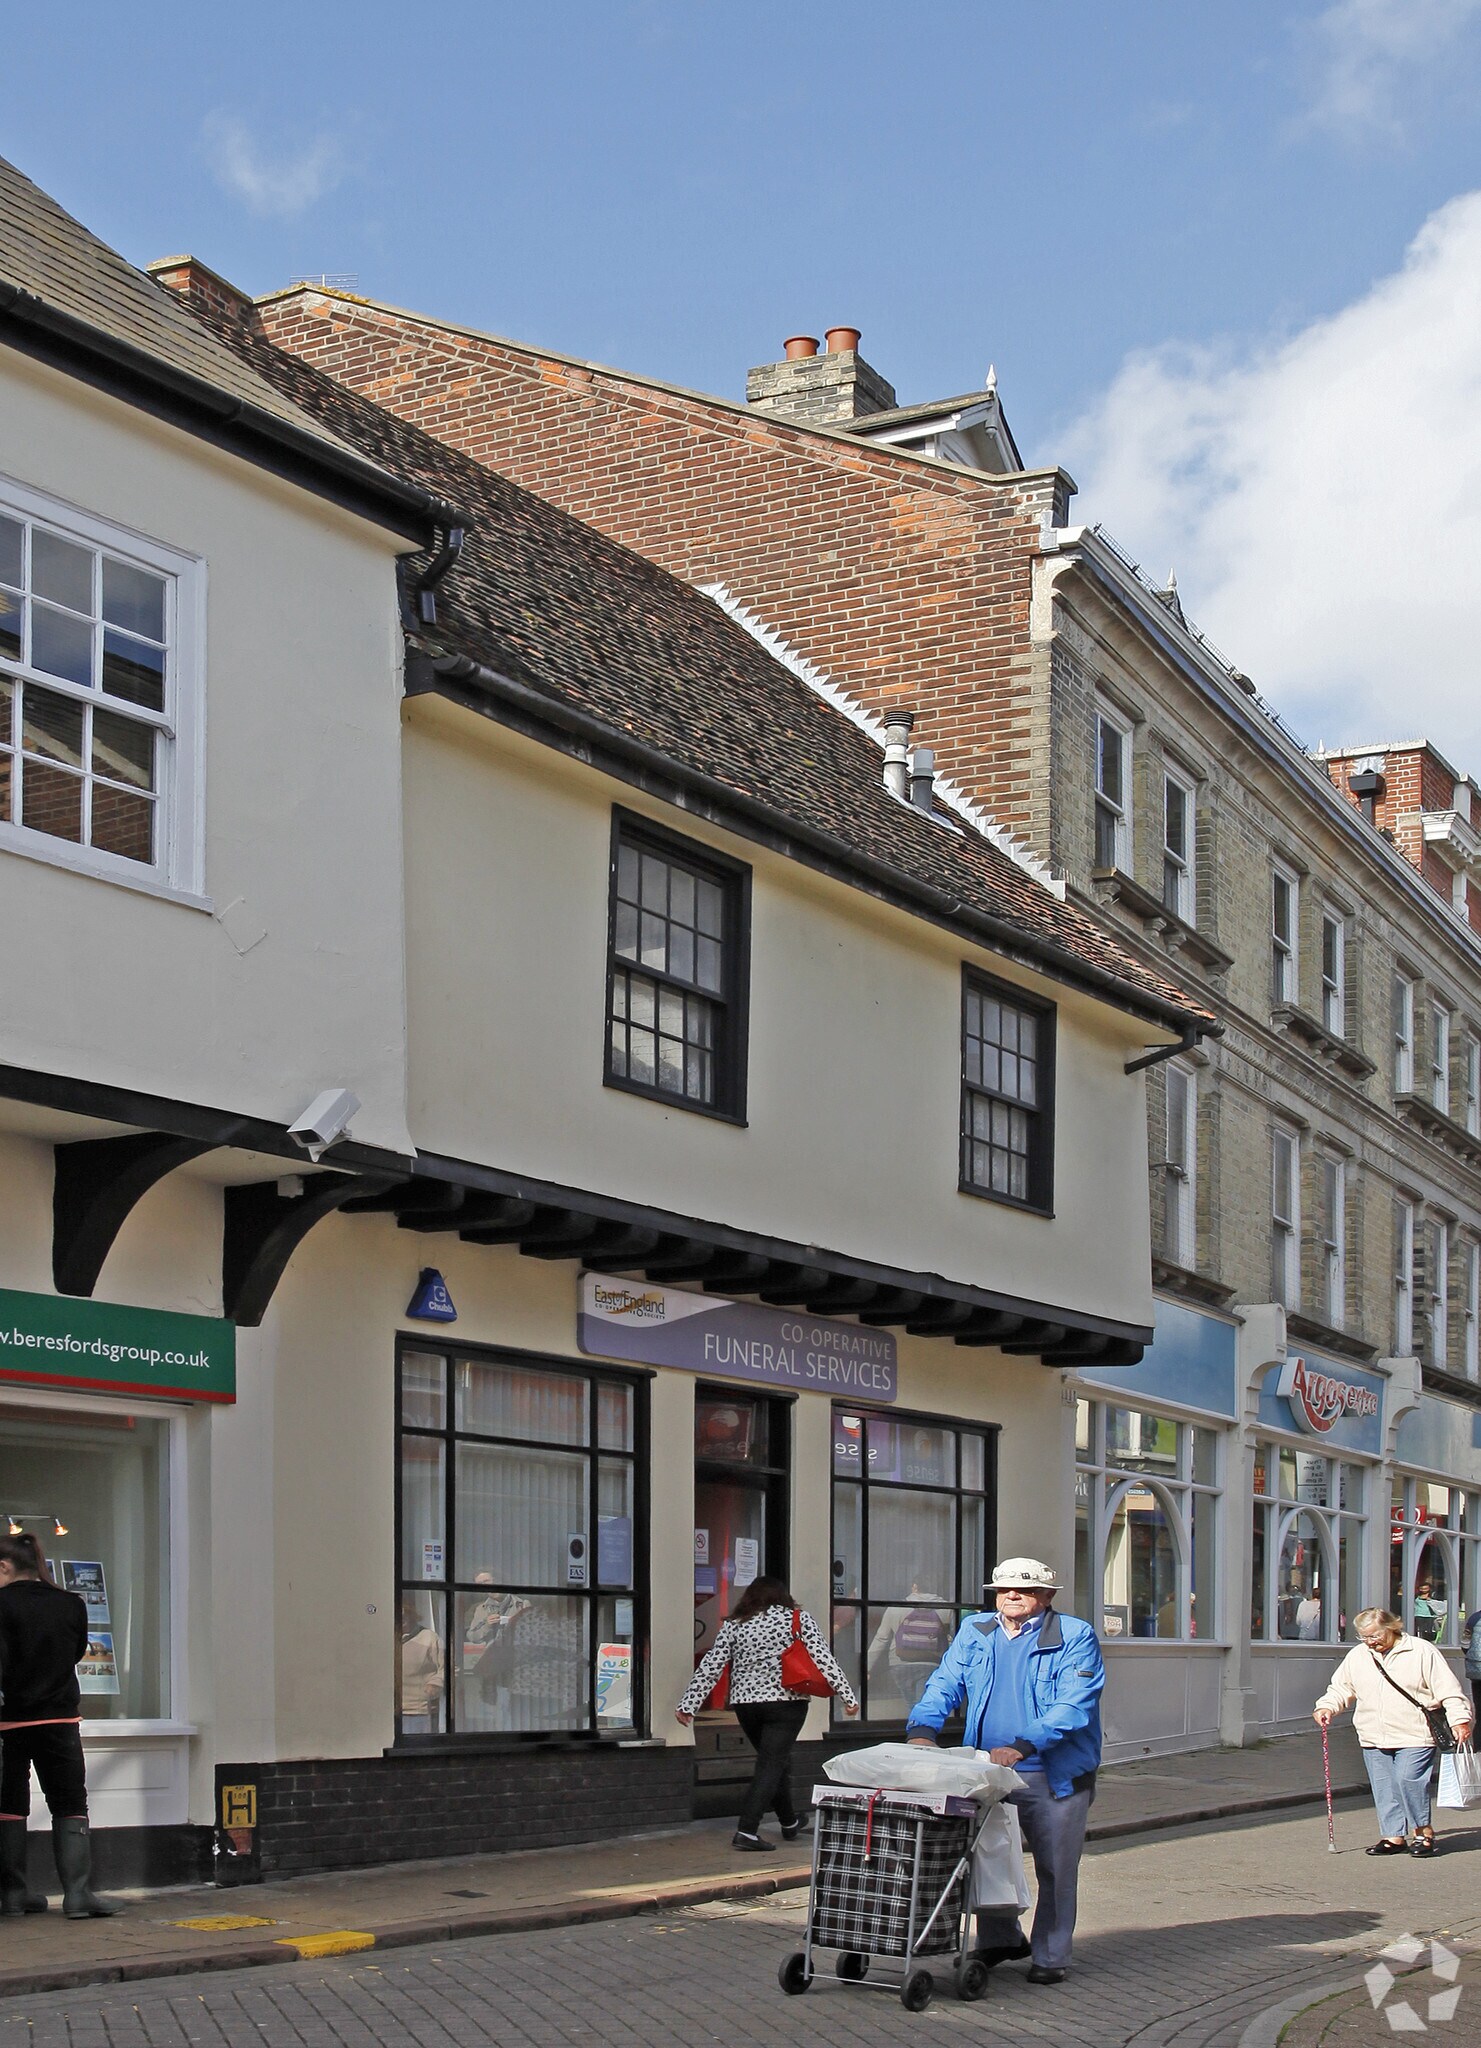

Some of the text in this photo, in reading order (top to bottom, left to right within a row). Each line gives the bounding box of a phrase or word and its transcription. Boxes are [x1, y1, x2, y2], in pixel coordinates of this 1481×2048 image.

[428, 1301, 453, 1313] Chubb
[595, 1285, 617, 1306] East
[623, 1290, 665, 1317] England
[781, 1322, 892, 1361] CO-OPERATIVE
[704, 1333, 892, 1391] FUNERAL SERVICES
[1291, 1357, 1378, 1433] Argos extra
[570, 1568, 584, 1576] FAS
[227, 1790, 252, 1824] H
